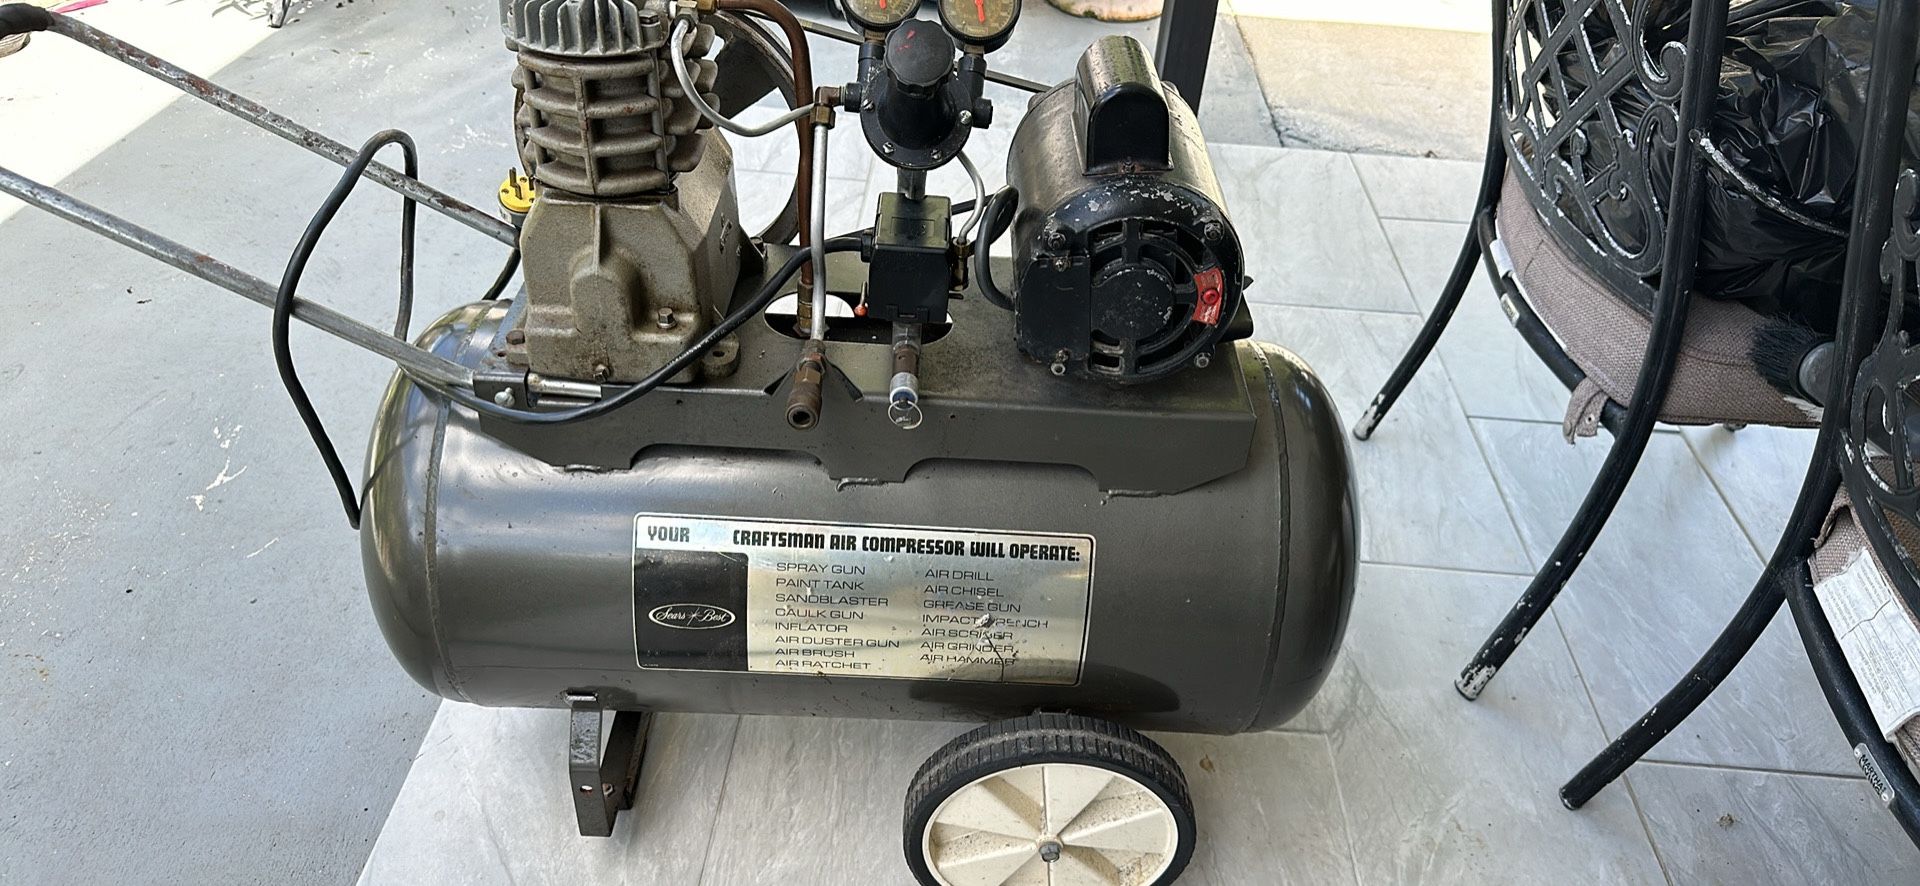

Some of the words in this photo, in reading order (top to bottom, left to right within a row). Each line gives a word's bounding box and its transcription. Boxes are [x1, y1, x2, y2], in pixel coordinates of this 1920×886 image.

[648, 526, 690, 542] YOUR
[733, 529, 825, 549] CRAFTSMAN
[829, 535, 857, 551] AIR
[862, 536, 965, 556] COMPRESSOR
[970, 542, 1005, 558] WILL
[1009, 543, 1080, 562] OPERATE:
[776, 562, 828, 574] SPRAY
[831, 565, 866, 575] GUN
[925, 569, 949, 579] AIR
[952, 571, 994, 581] DRILL
[776, 578, 820, 589] PAINT
[824, 580, 864, 590] TANK
[924, 585, 948, 595] AIR
[951, 586, 1004, 598] CHISEL
[775, 594, 889, 606] SANDBLASTER
[923, 600, 984, 611] GREASE
[987, 602, 1021, 613] GUN
[655, 606, 686, 620] Sears
[698, 608, 728, 622] Best
[775, 608, 826, 619] CAULK
[830, 610, 864, 620] GUN
[775, 622, 848, 633] INFLATOR
[922, 614, 979, 625] IMPACT
[983, 617, 1049, 629] RENCH
[921, 628, 946, 637] AIR
[775, 635, 799, 644] AIR
[802, 636, 863, 647] DUSTER
[866, 639, 900, 648] GUN
[920, 641, 945, 650] AIR
[947, 642, 1014, 653] GRINDER
[775, 648, 799, 656] AIR
[802, 650, 855, 658] BRUSH
[775, 659, 799, 667] AIR
[802, 660, 871, 670] RATCHET
[920, 654, 944, 662] AIR
[946, 655, 1016, 666] HAMMER
